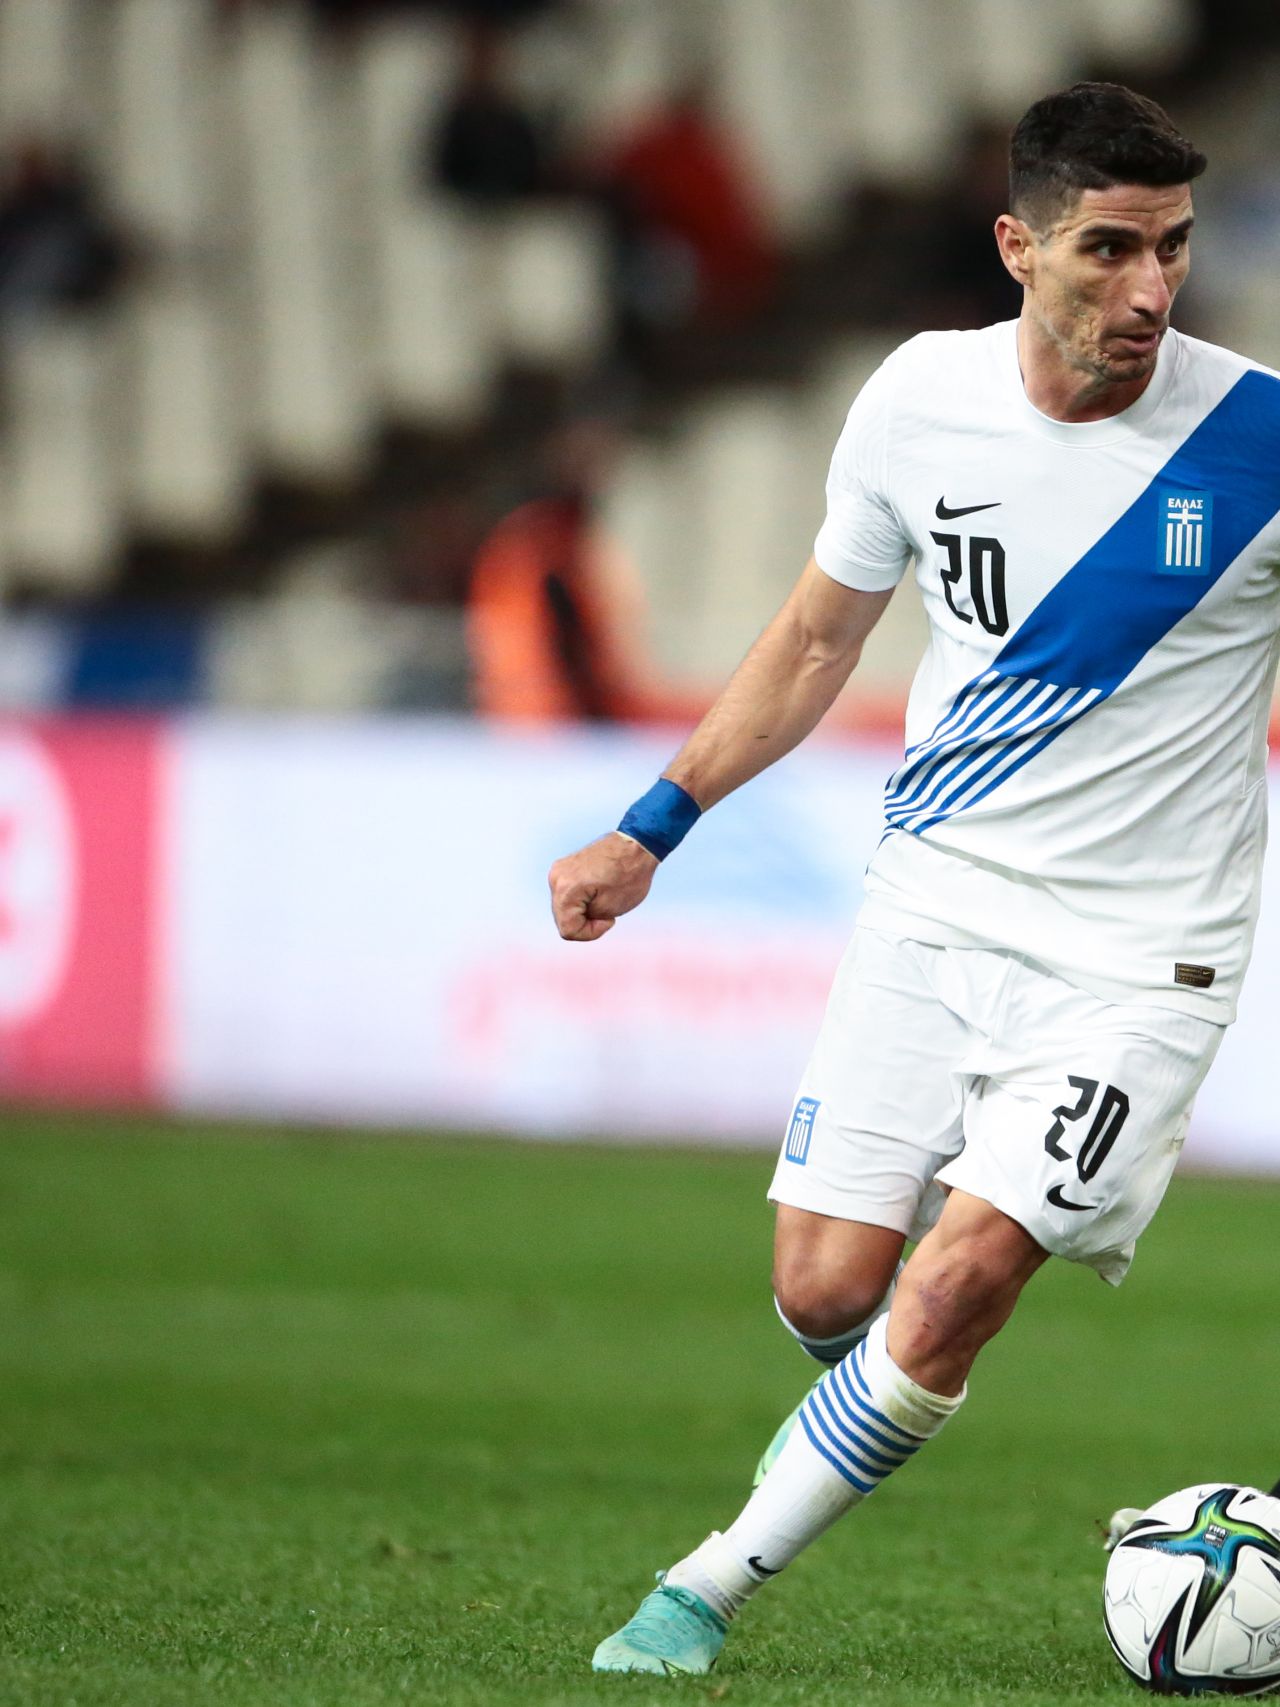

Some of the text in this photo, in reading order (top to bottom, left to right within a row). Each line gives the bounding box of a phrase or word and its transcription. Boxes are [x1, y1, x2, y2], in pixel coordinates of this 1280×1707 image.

[1167, 497, 1204, 509] ΕΛΛΑΣ
[928, 530, 1010, 637] 20
[1044, 1074, 1130, 1185] 20
